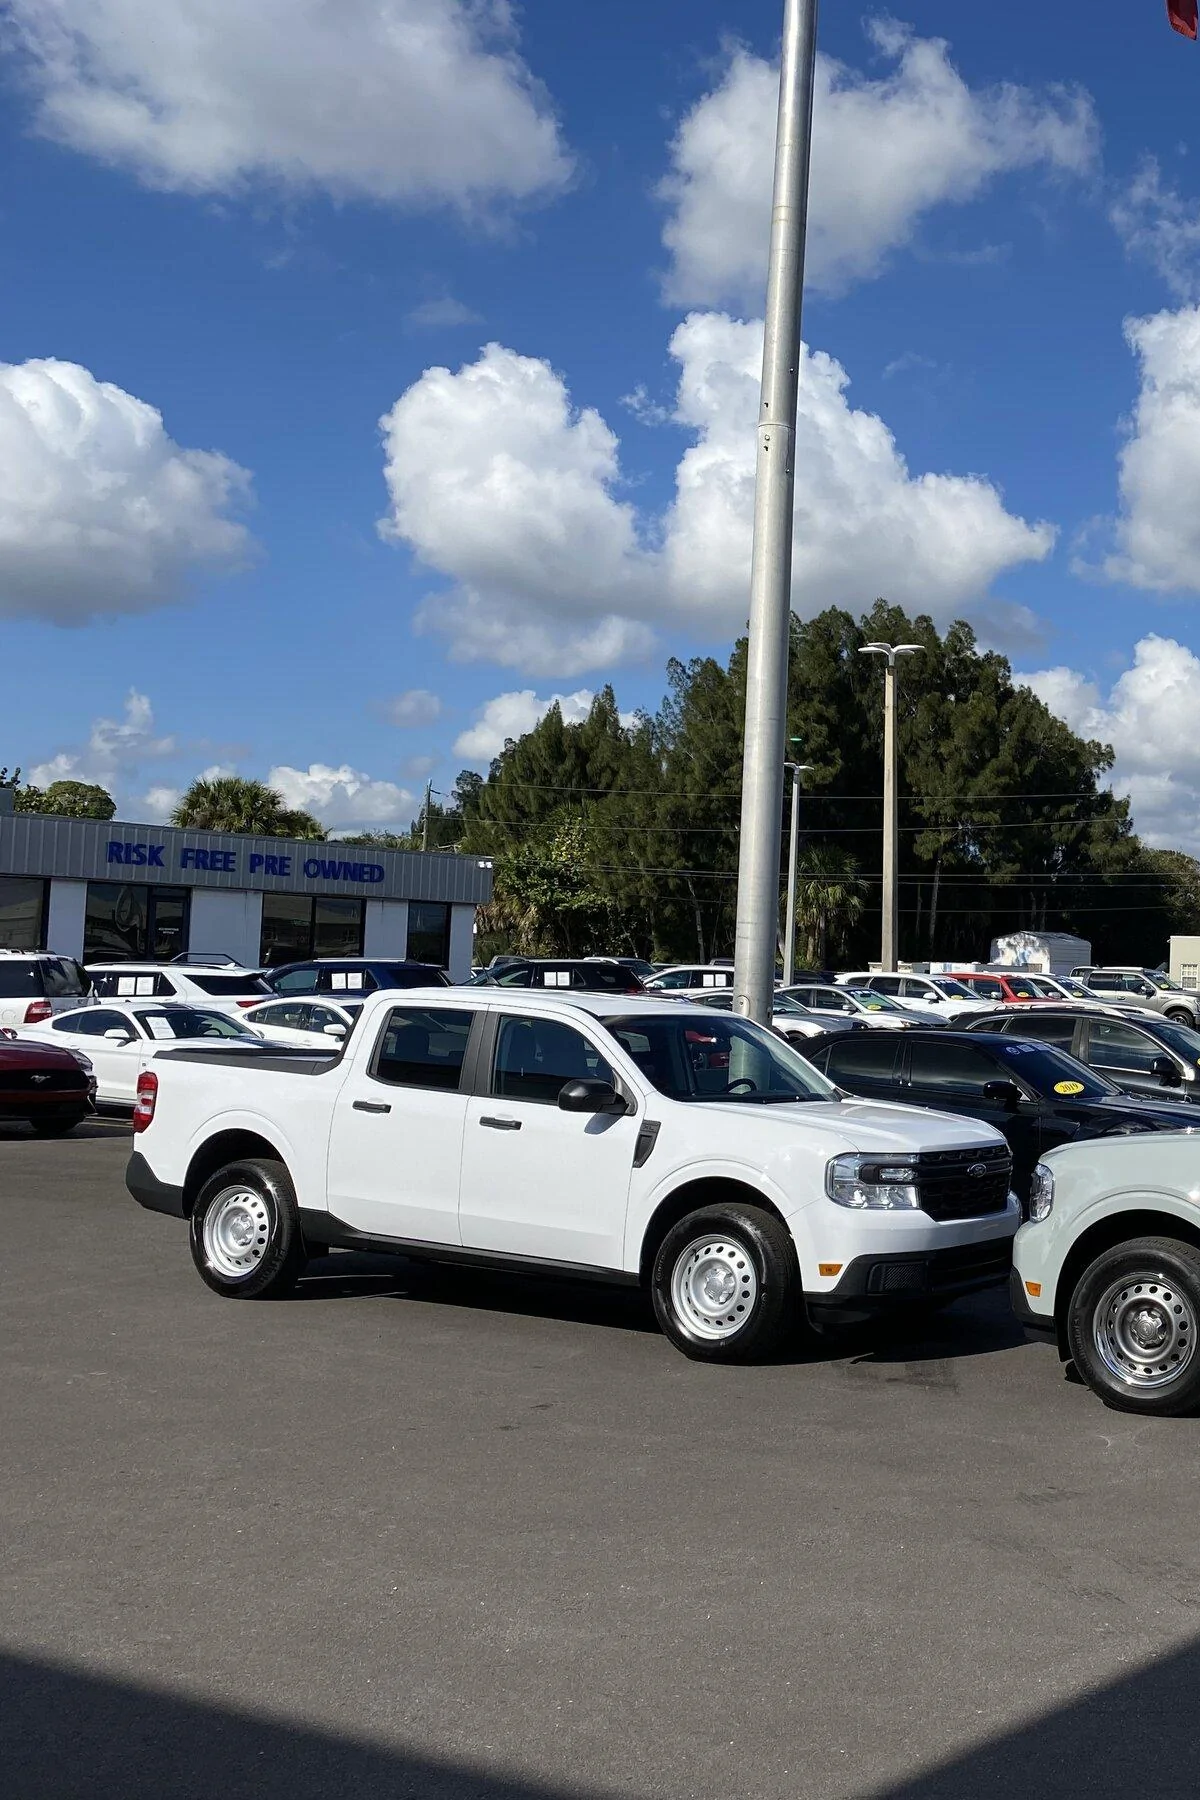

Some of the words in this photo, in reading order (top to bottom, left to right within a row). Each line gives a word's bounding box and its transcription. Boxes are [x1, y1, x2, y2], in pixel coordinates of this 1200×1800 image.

[107, 841, 166, 867] RISK
[180, 847, 237, 873] FREE
[249, 853, 293, 877] PRE
[303, 858, 385, 883] OWNED
[1060, 1082, 1079, 1093] 2019
